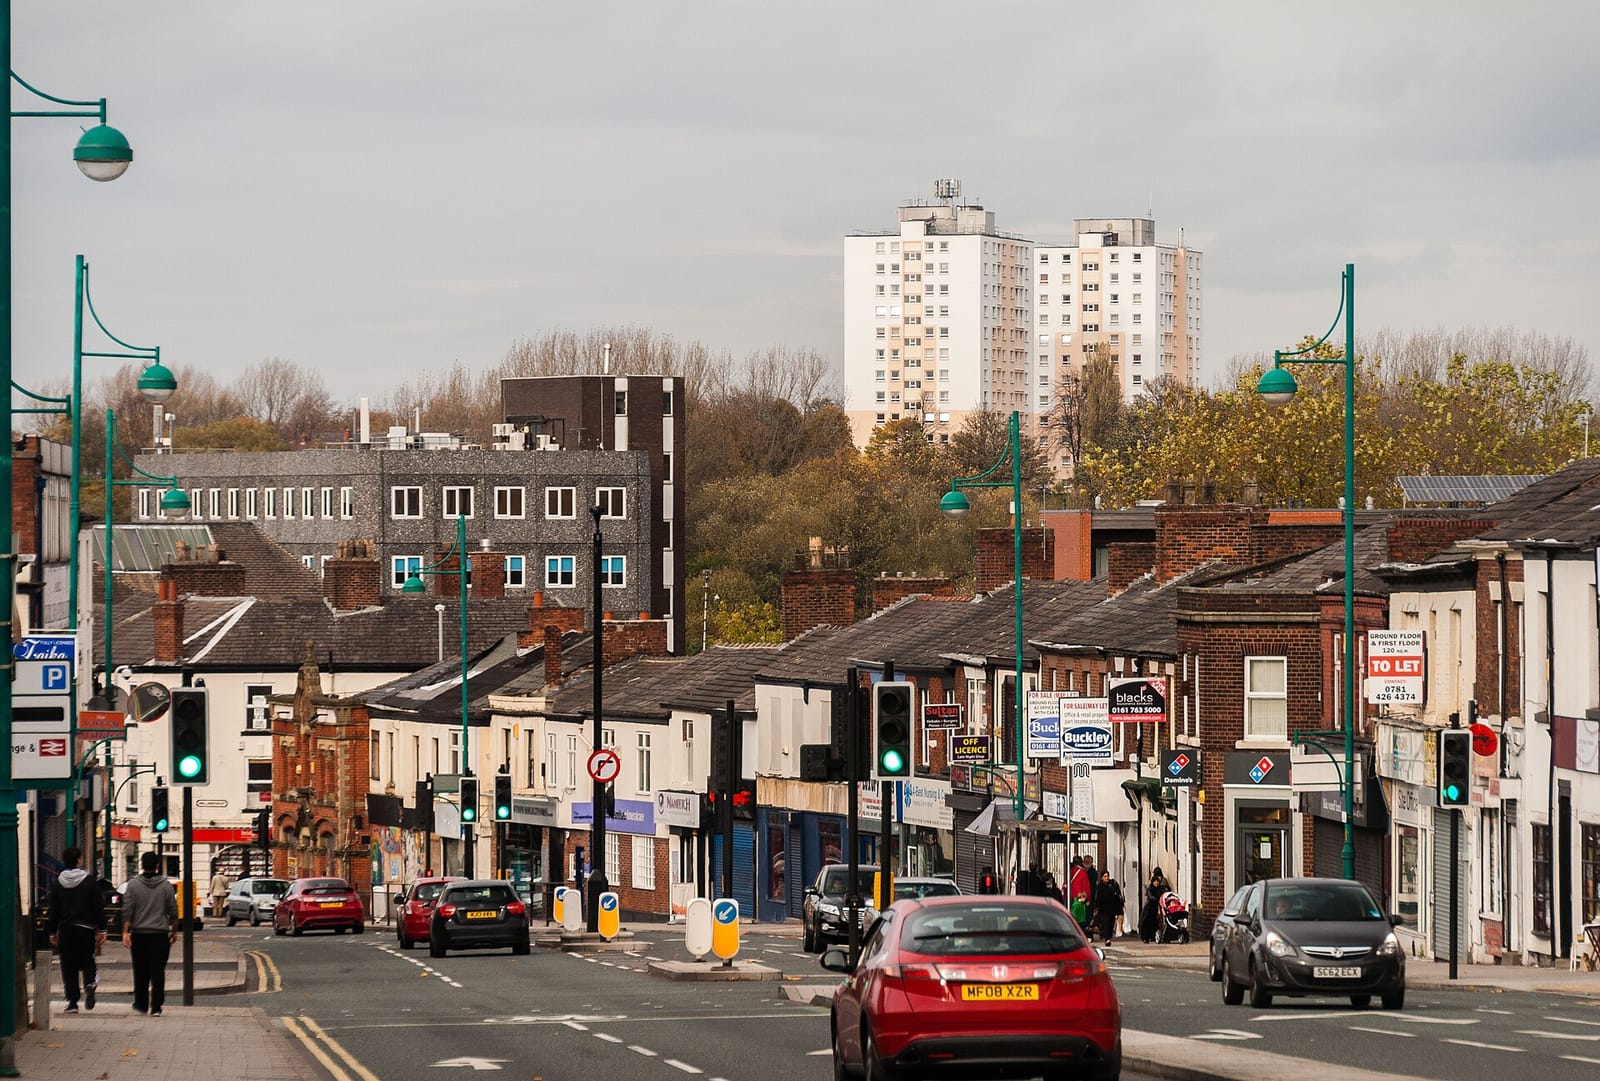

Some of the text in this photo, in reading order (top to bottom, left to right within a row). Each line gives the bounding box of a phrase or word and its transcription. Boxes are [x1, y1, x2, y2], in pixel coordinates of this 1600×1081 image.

[1371, 660, 1420, 673] TO LET
[1116, 688, 1154, 702] blacks
[926, 707, 958, 717] Sultan
[1064, 732, 1109, 744] Buckley
[29, 743, 35, 752] &
[1164, 776, 1193, 784] Domino's
[1317, 968, 1339, 976] SC62
[967, 986, 1032, 997] MF08 XZR
